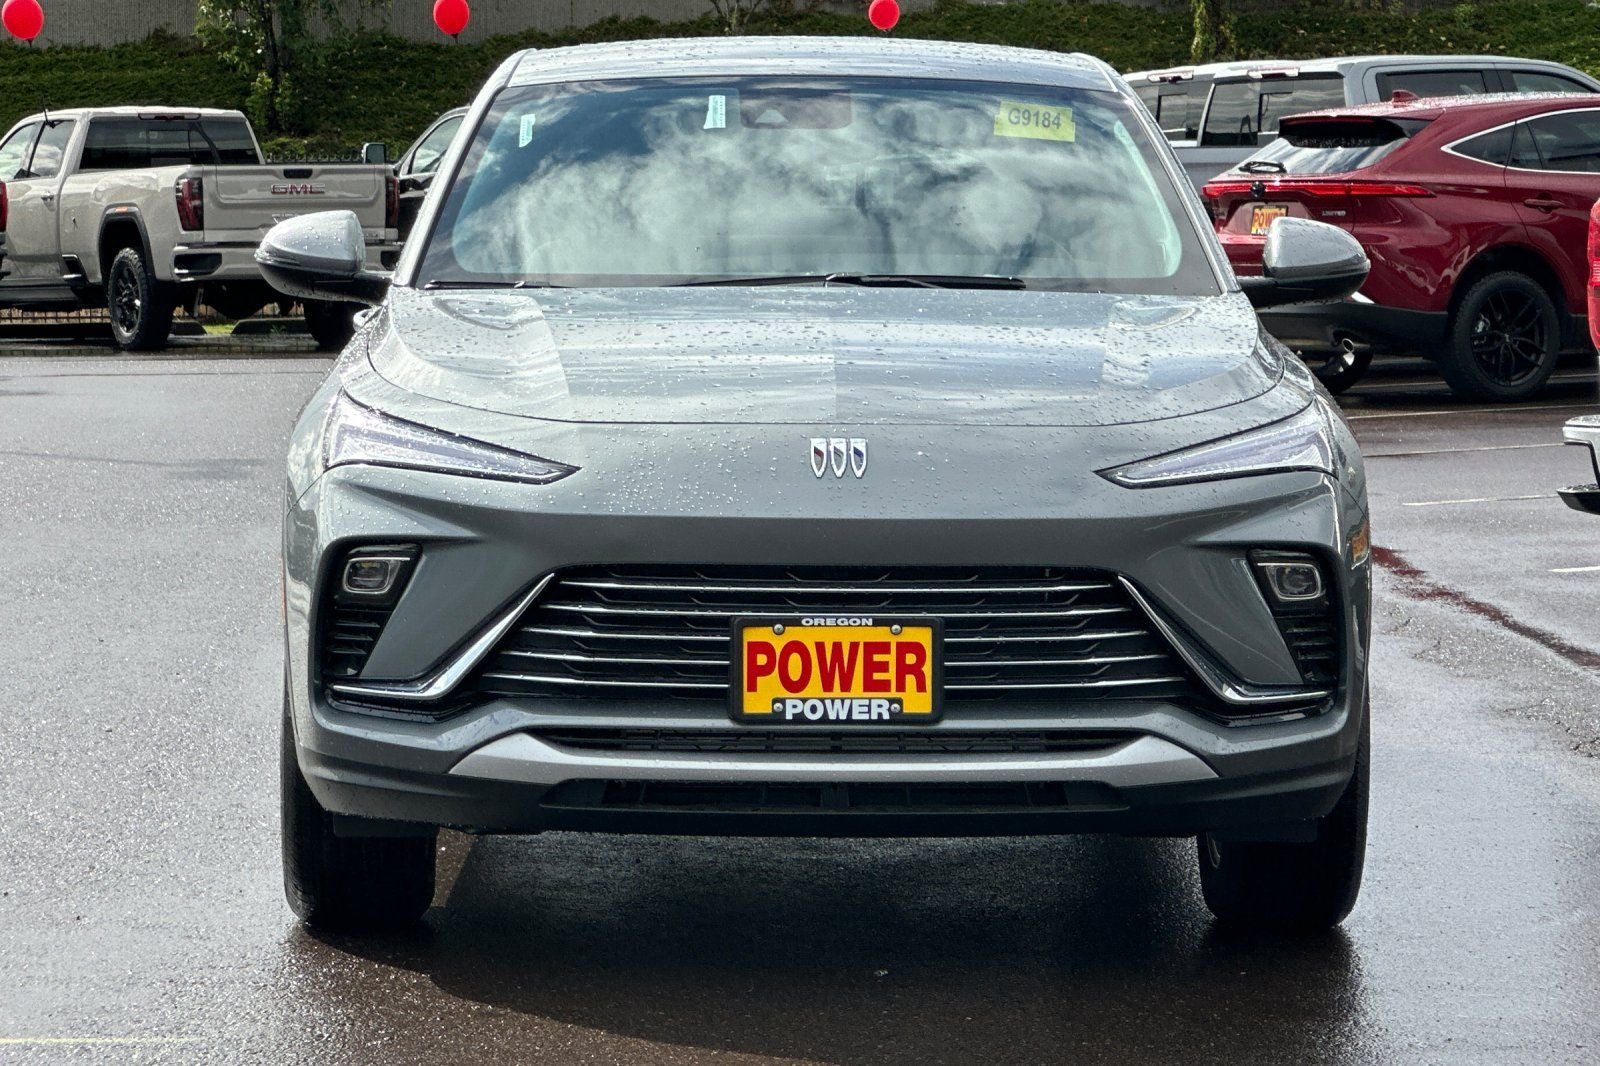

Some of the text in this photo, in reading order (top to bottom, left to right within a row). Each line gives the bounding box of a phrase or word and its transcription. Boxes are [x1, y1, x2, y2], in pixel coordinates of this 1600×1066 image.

[1007, 107, 1062, 129] G9184
[270, 184, 325, 194] GMC
[1253, 212, 1284, 228] POW
[801, 617, 873, 626] OREGON
[746, 640, 927, 694] POWER
[785, 699, 890, 720] POWER
